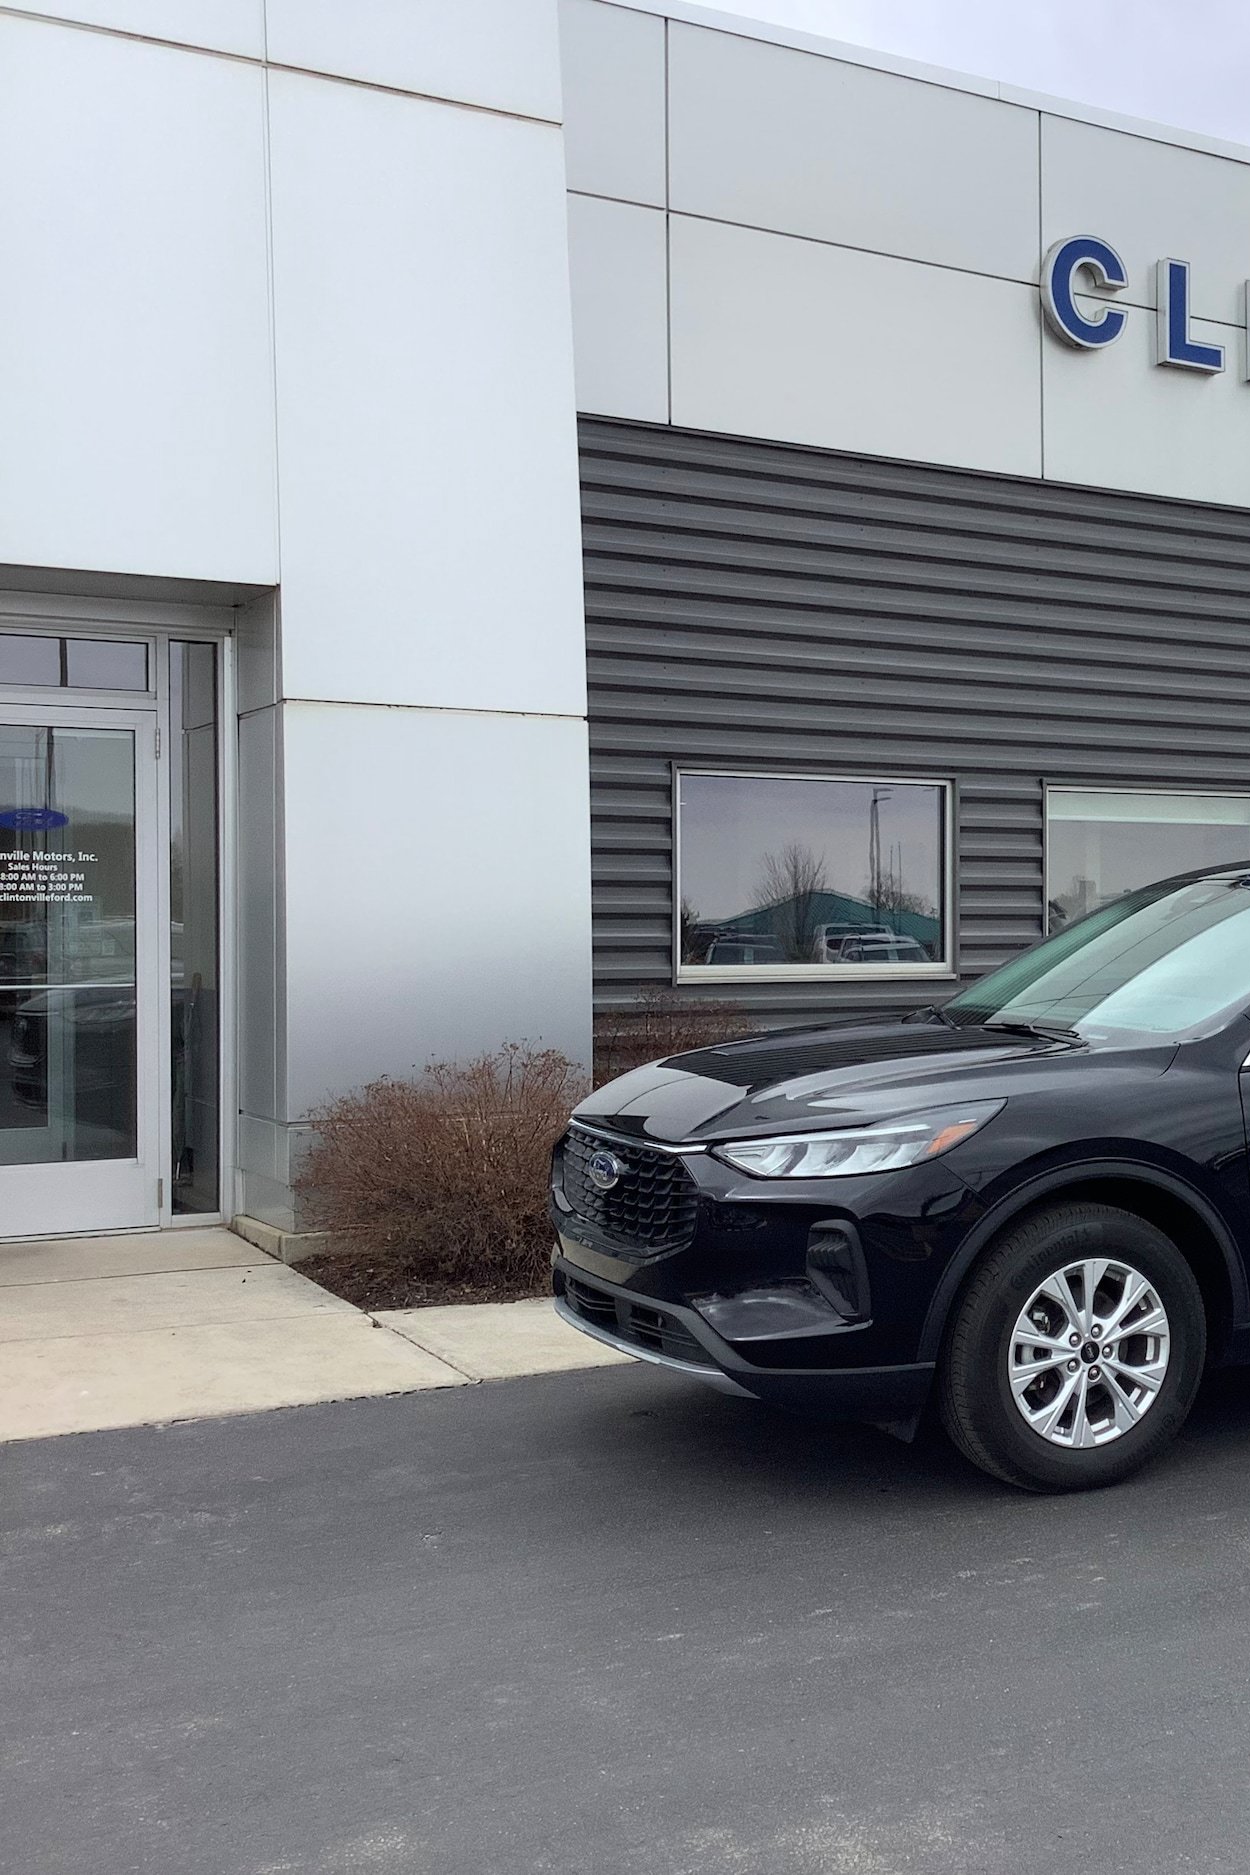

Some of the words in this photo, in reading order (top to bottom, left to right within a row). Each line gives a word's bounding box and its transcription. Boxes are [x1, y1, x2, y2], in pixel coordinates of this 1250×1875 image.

[32, 851, 76, 862] Motors,
[78, 851, 98, 862] Inc.
[8, 863, 30, 871] Sales
[32, 863, 58, 871] Hours
[21, 872, 36, 881] AM
[38, 873, 48, 881] to
[50, 873, 68, 881] 6:00
[70, 873, 85, 881] PM
[19, 882, 35, 891] AM
[37, 883, 46, 891] to
[48, 883, 66, 891] 3:00
[68, 883, 83, 891] PM
